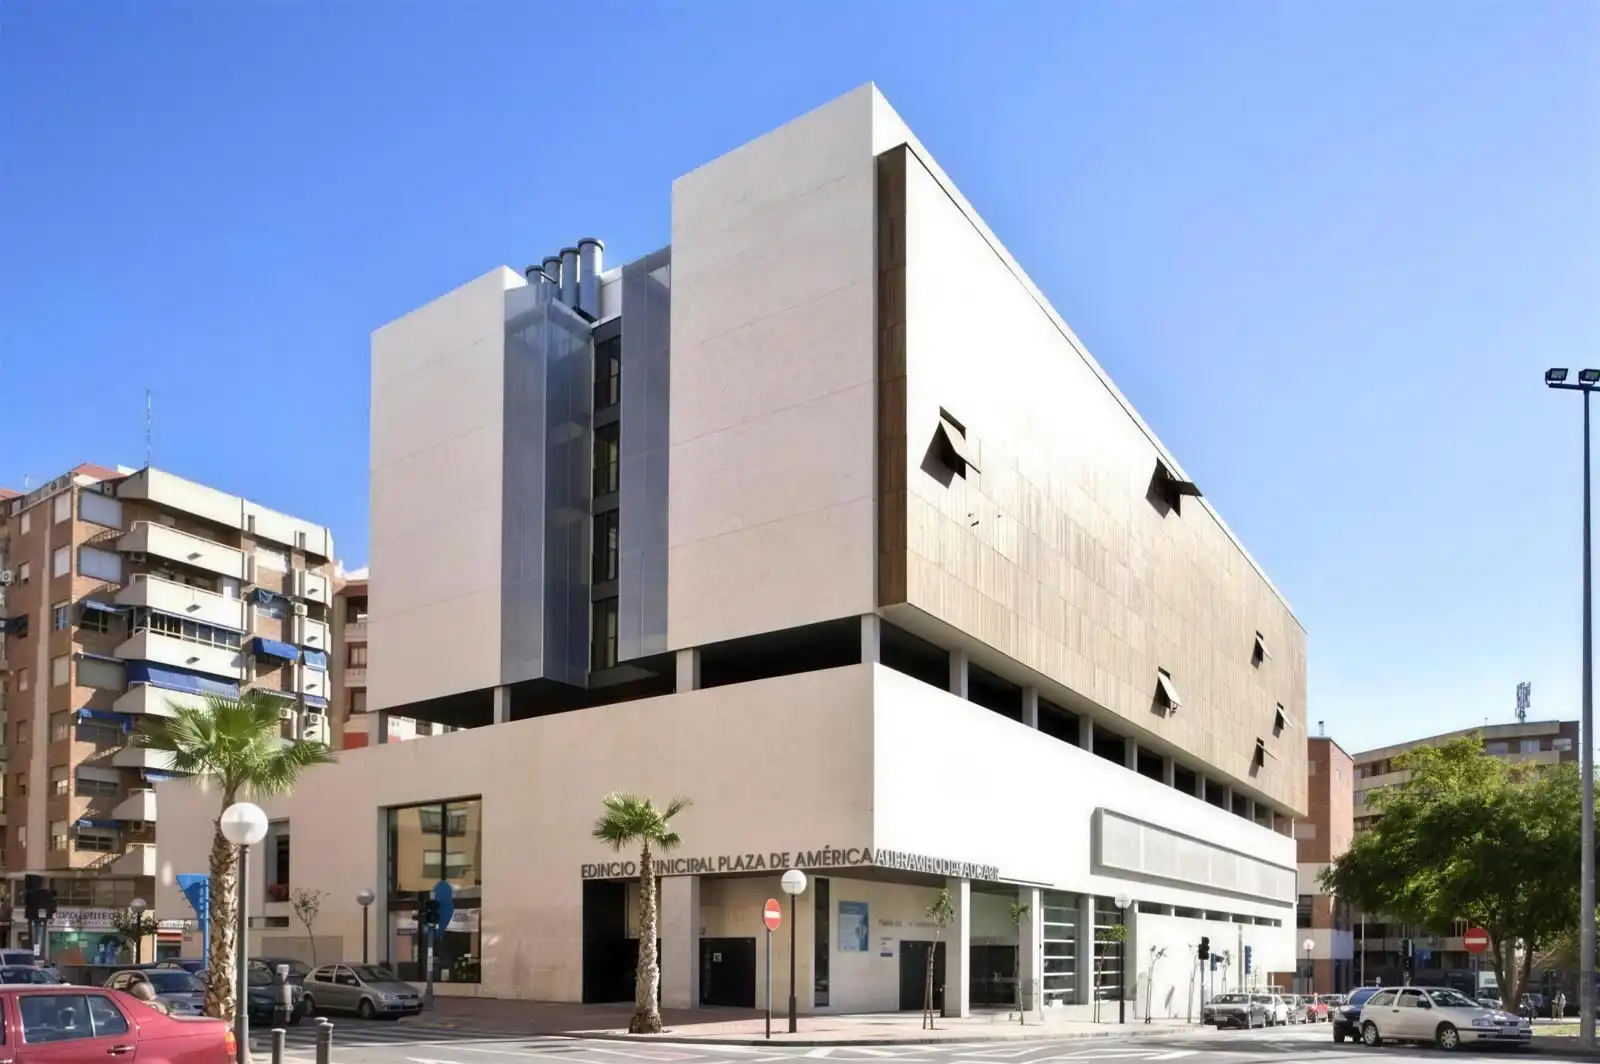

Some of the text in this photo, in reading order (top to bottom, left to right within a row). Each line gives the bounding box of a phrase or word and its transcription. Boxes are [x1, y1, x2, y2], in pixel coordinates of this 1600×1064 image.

[718, 852, 766, 871] PLAZA
[770, 852, 790, 869] DE
[794, 845, 873, 868] AMÉRICA
